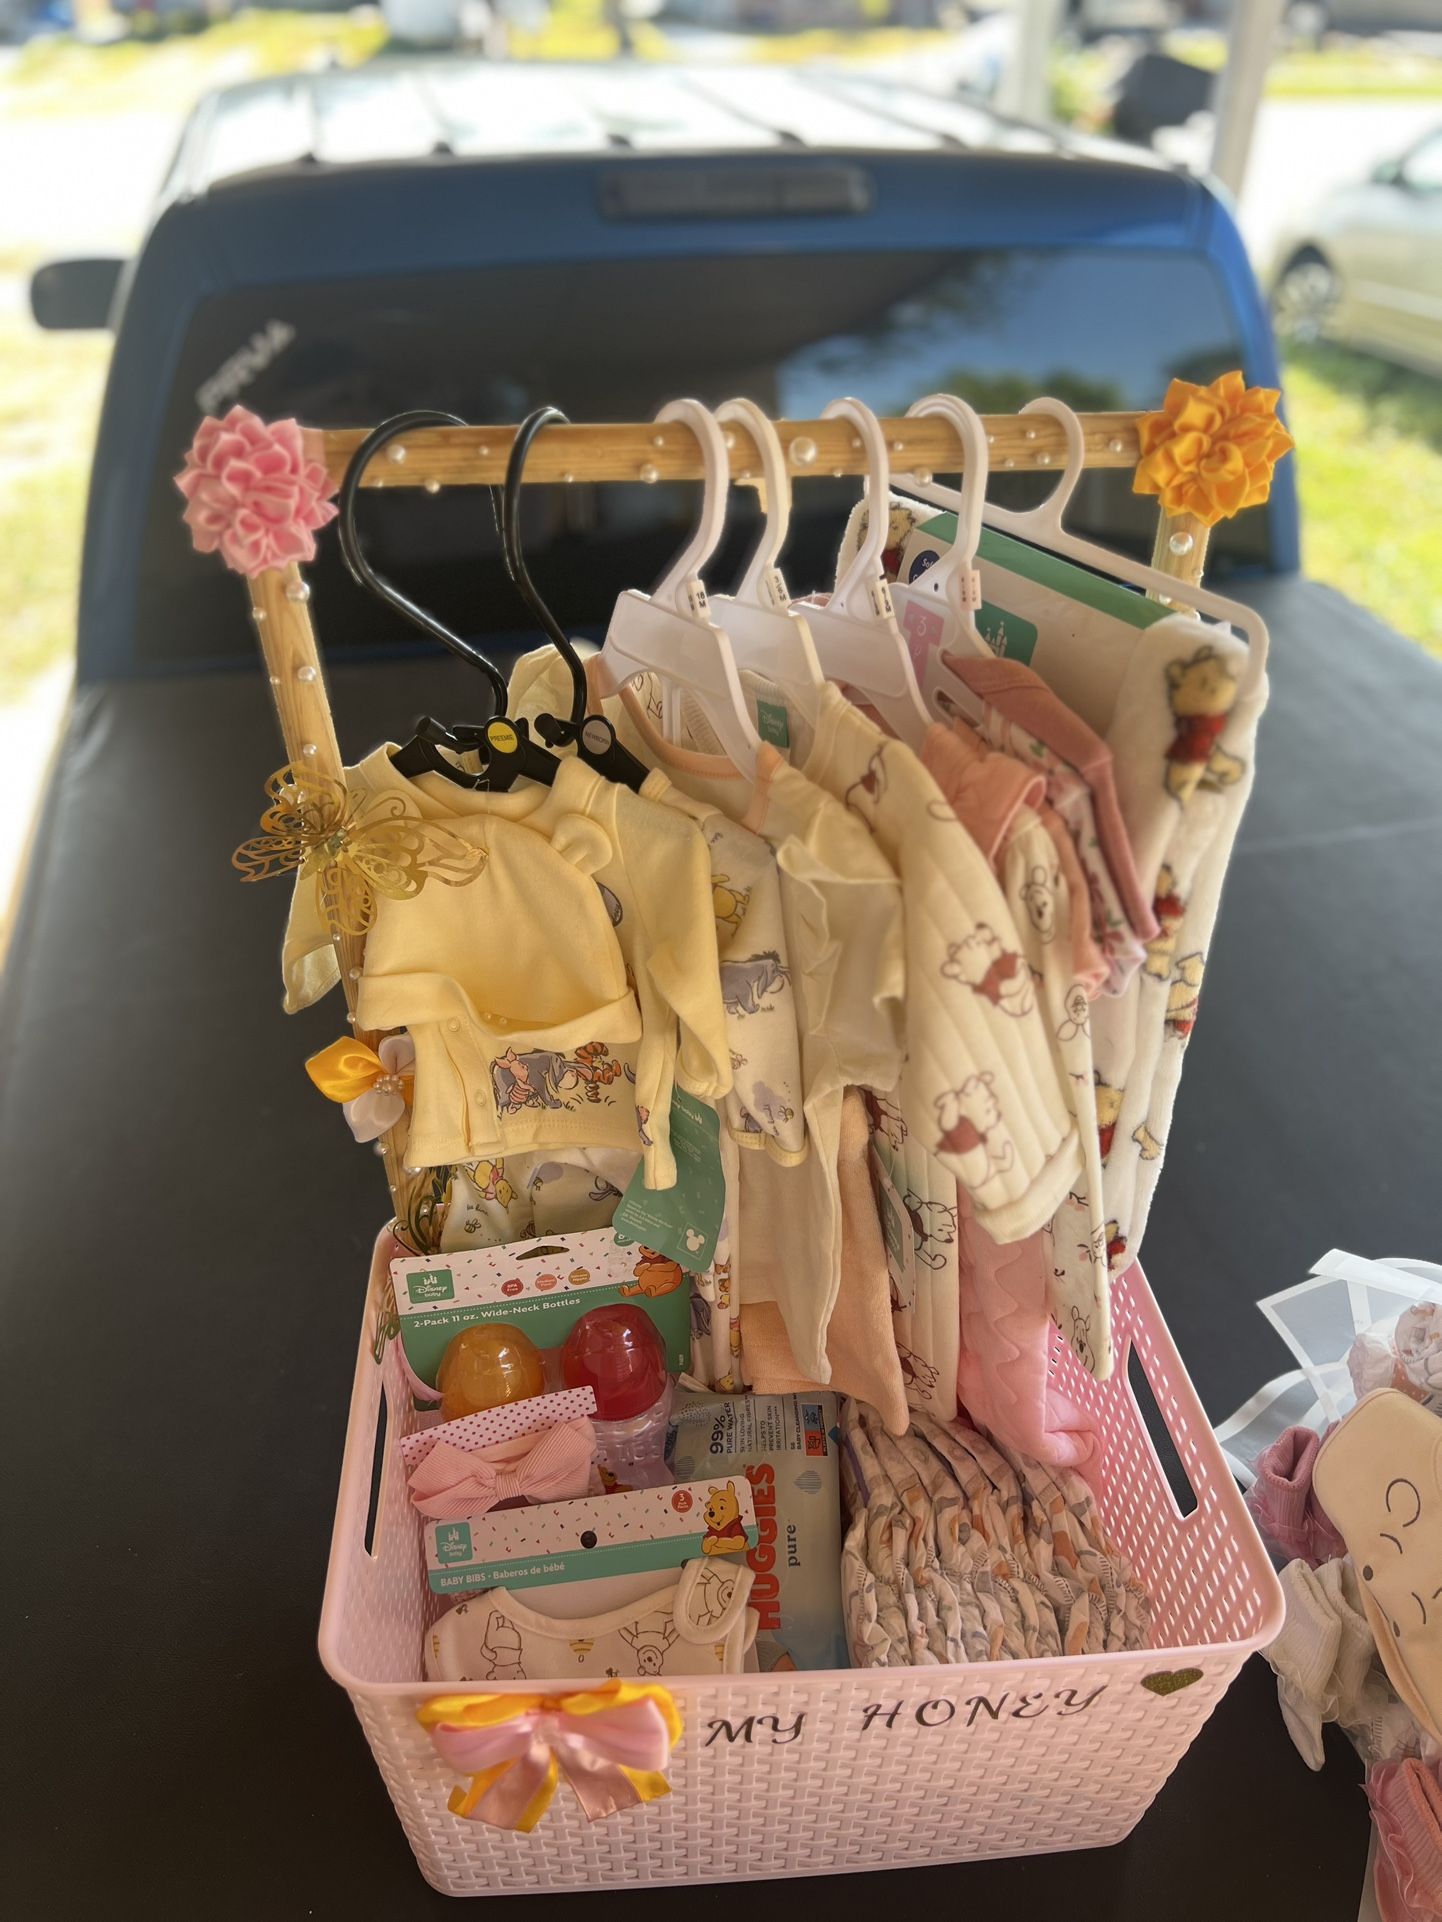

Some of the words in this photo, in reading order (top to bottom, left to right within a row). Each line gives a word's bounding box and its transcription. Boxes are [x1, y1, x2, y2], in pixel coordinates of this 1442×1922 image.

[760, 710, 784, 731] Disney
[489, 733, 514, 744] PREEMIE
[584, 731, 611, 745] NEWBORN
[412, 1283, 448, 1295] Disney
[413, 1316, 450, 1328] 2-Pack
[452, 1314, 461, 1323] 11
[463, 1312, 479, 1321] oz.
[481, 1303, 540, 1318] Wide-Neck
[542, 1297, 581, 1309] Bottles
[723, 1402, 734, 1431] WATER
[759, 1420, 767, 1431] TO
[709, 1414, 726, 1455] 99%
[725, 1432, 734, 1454] PURE
[767, 1422, 775, 1451] PREVENT
[679, 1493, 686, 1502] 3
[440, 1541, 468, 1553] Disney
[746, 1462, 781, 1630] HUGGIES
[784, 1523, 801, 1568] pure
[440, 1575, 464, 1587] BABY
[466, 1572, 486, 1583] BIBS
[493, 1567, 528, 1580] Baberos
[530, 1565, 541, 1575] de
[543, 1561, 566, 1573] bébé
[704, 1710, 808, 1747] MY
[861, 1684, 1110, 1732] HONEY
